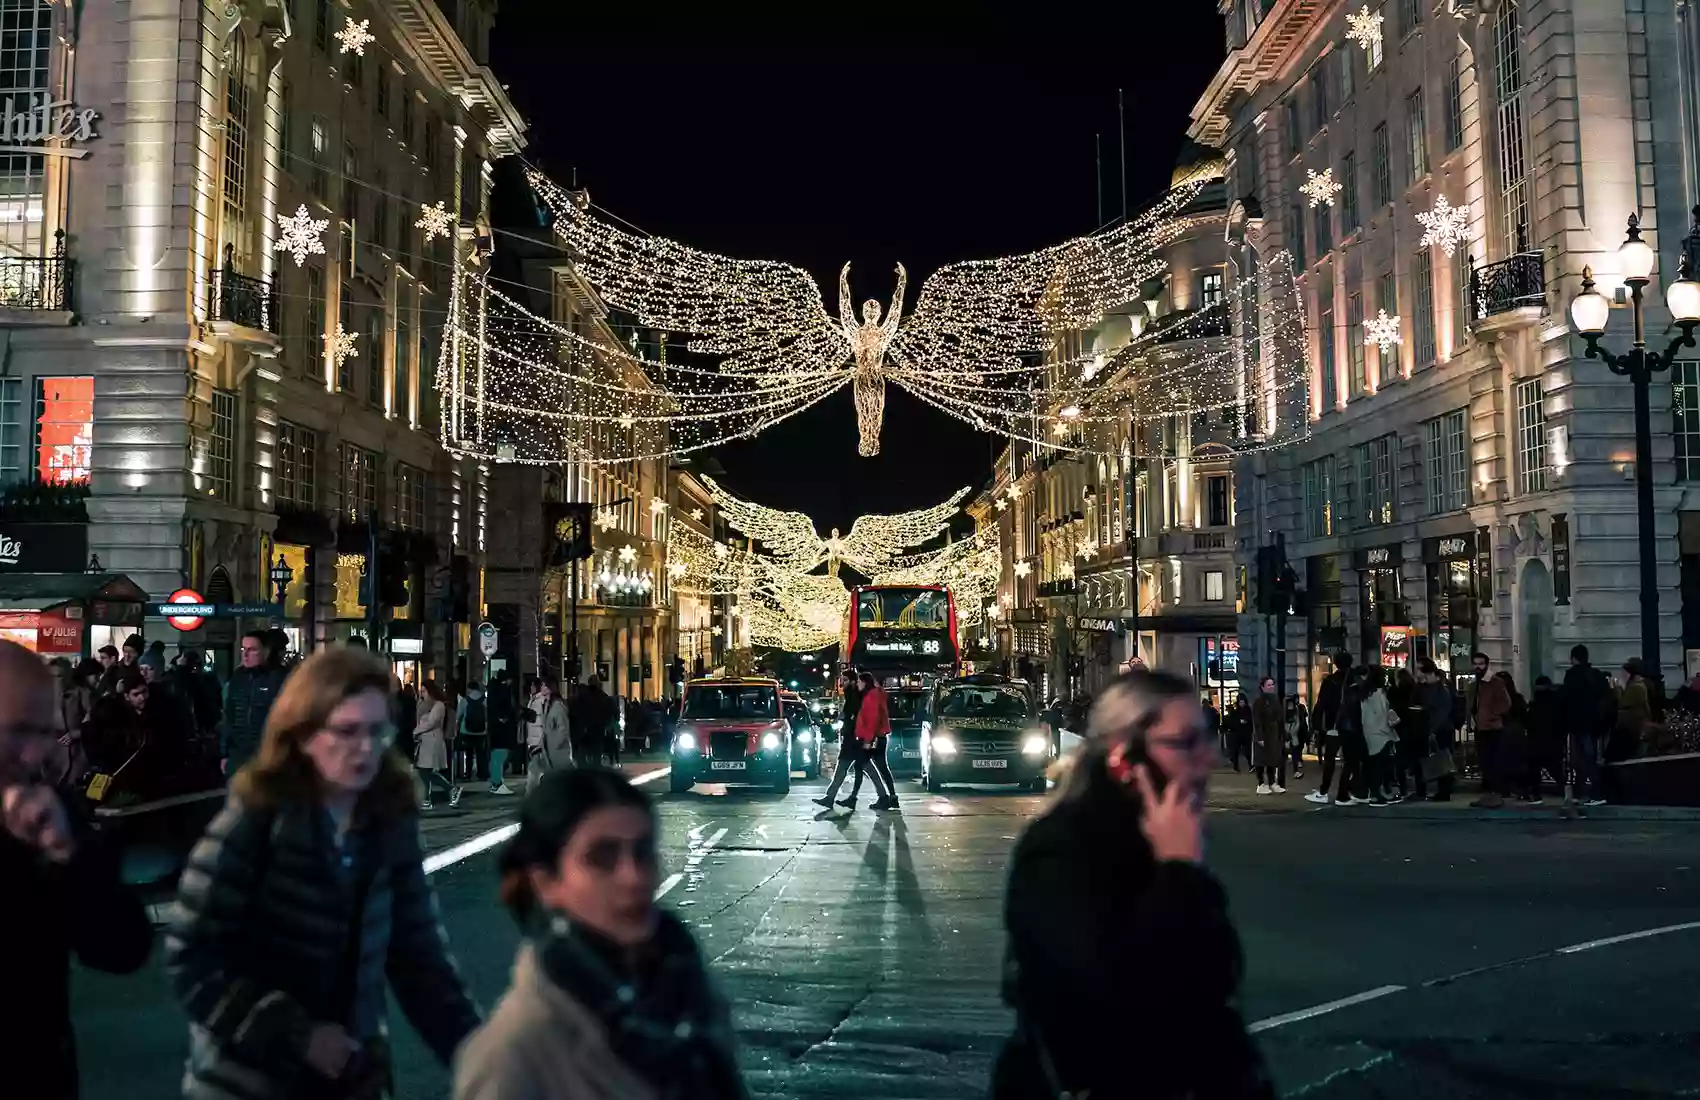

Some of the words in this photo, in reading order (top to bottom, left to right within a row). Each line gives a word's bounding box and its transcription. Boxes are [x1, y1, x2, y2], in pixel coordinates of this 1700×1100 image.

[0, 92, 95, 141] hites
[159, 605, 213, 616] UNDERGROUND
[1385, 631, 1406, 640] Pizza
[923, 640, 940, 653] 88
[1387, 640, 1404, 648] Hut
